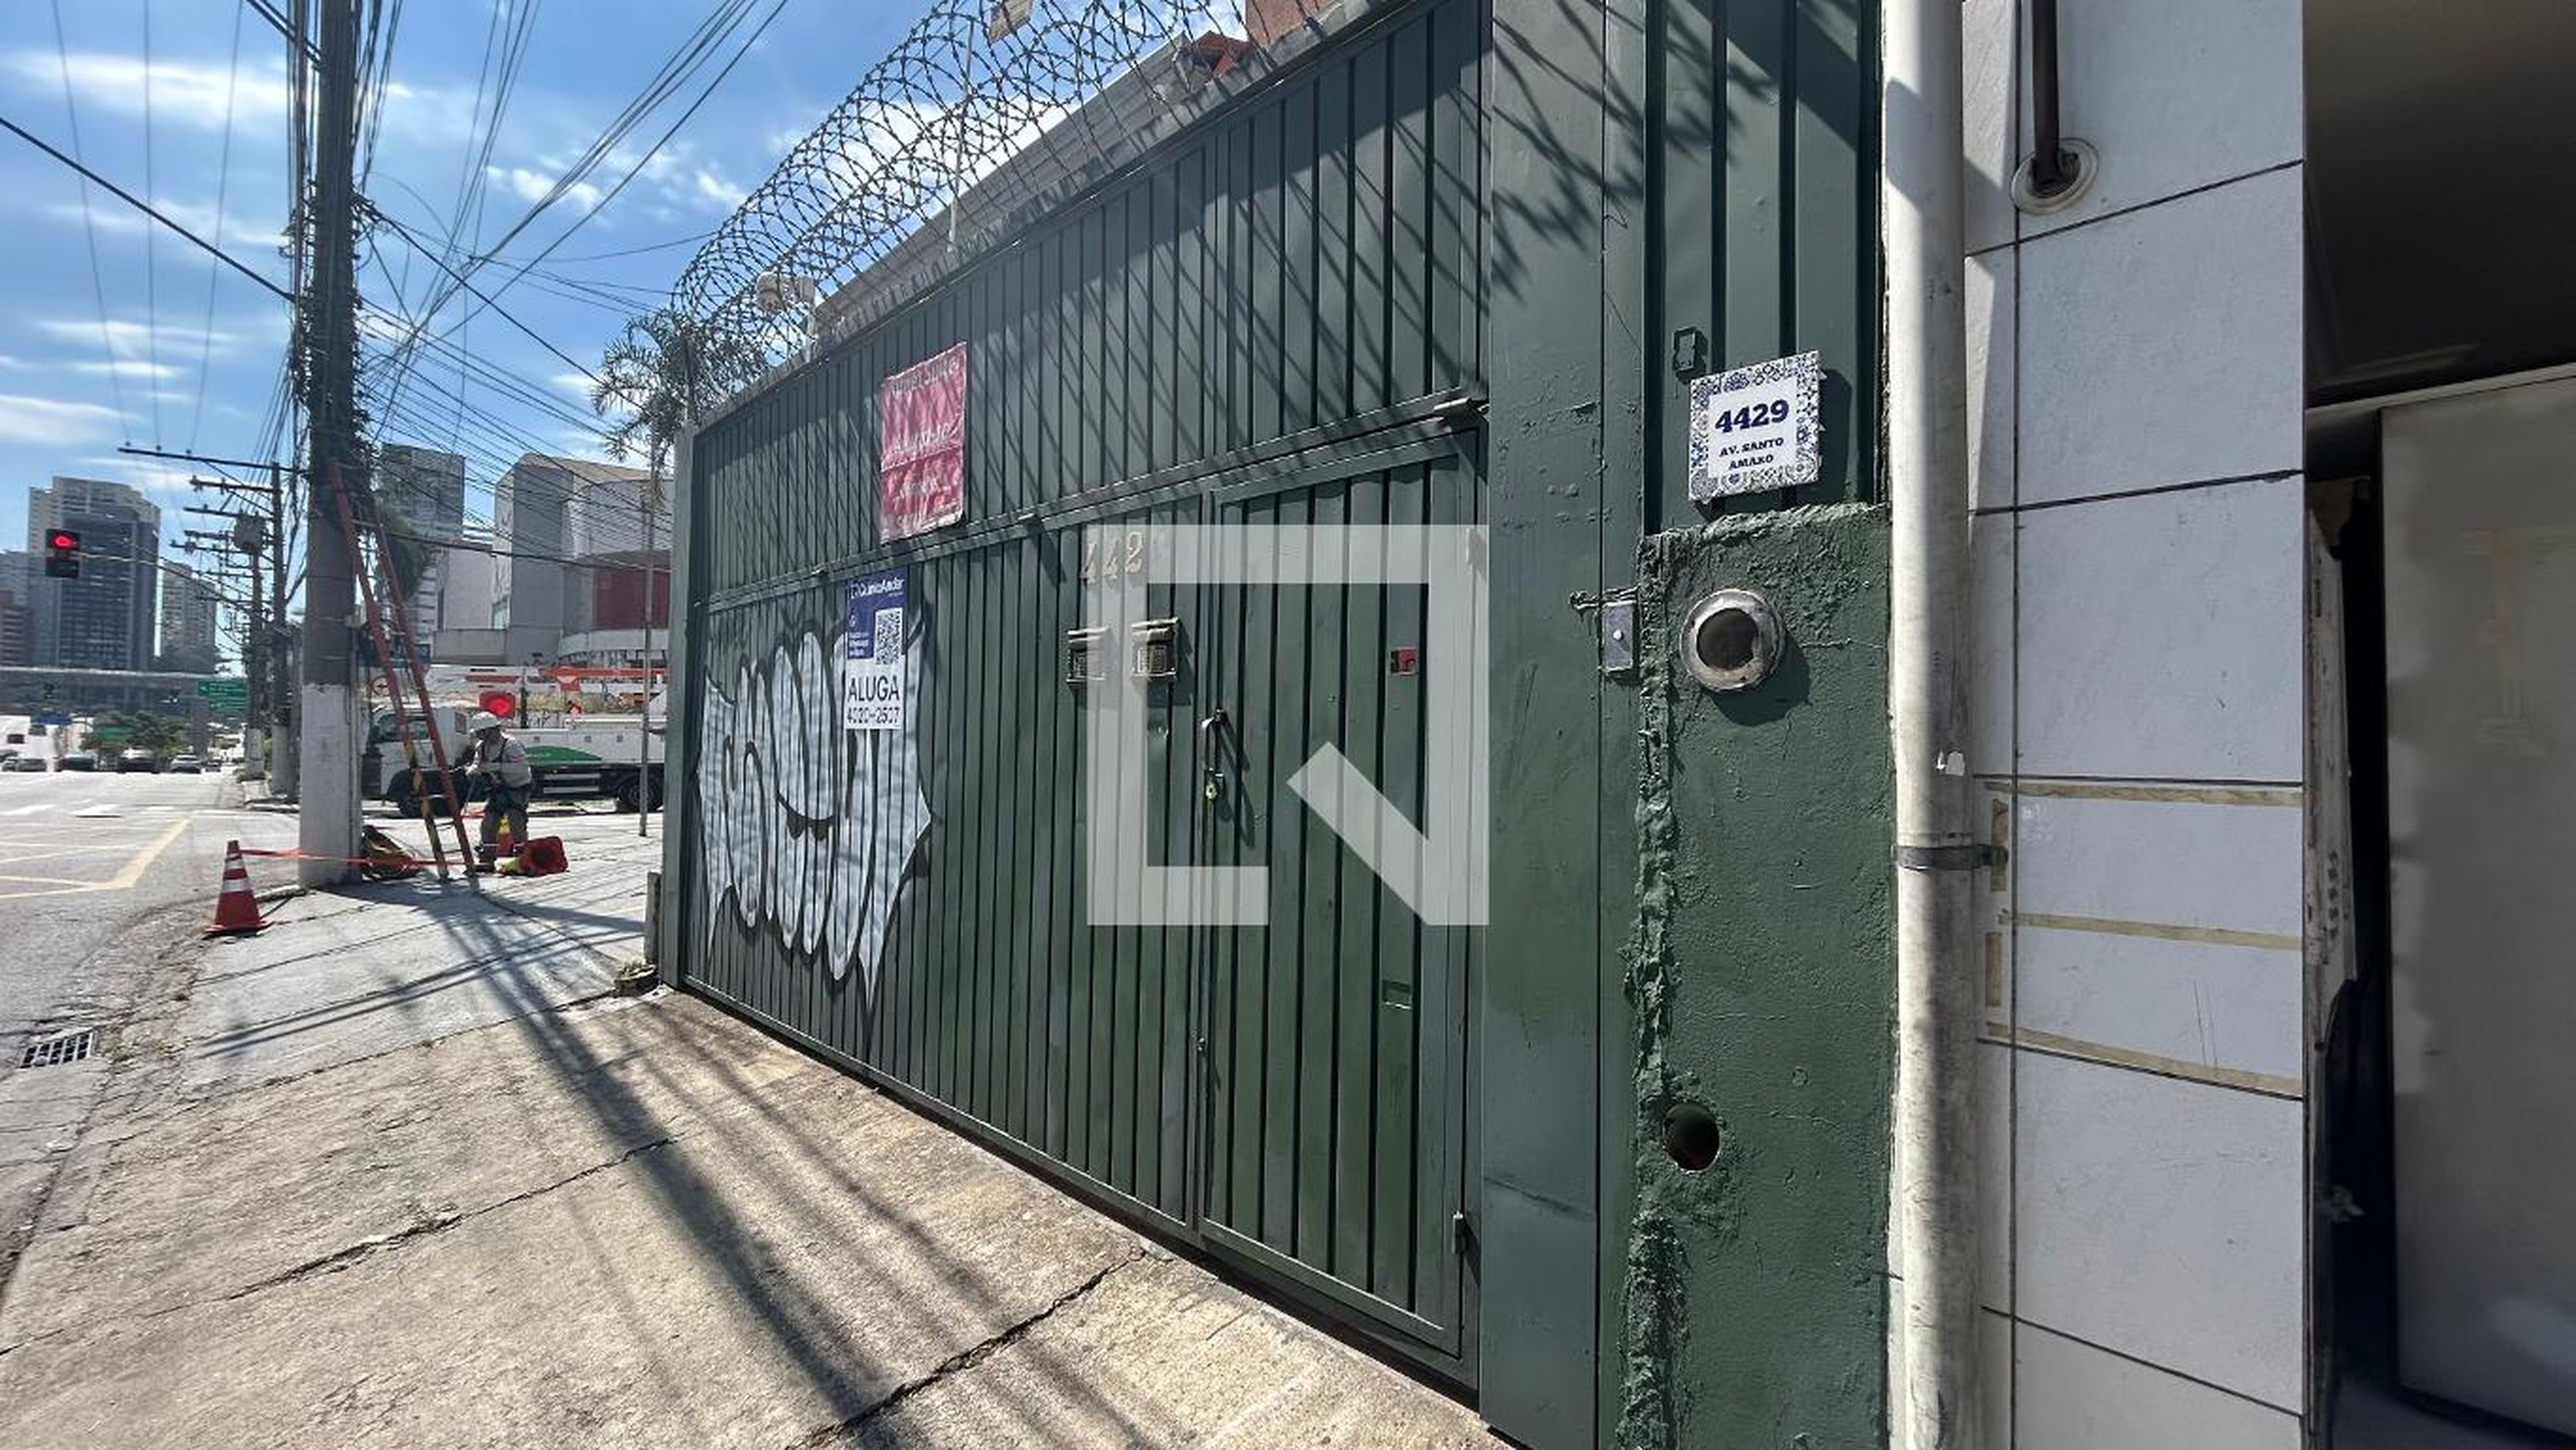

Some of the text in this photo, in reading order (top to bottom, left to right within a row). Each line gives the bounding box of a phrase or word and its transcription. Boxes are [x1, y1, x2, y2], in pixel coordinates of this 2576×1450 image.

[1715, 399, 1790, 433] 4429
[1719, 437, 1784, 458] AV. SANTO
[1729, 454, 1774, 470] AMARO
[847, 674, 900, 703] ALUGA
